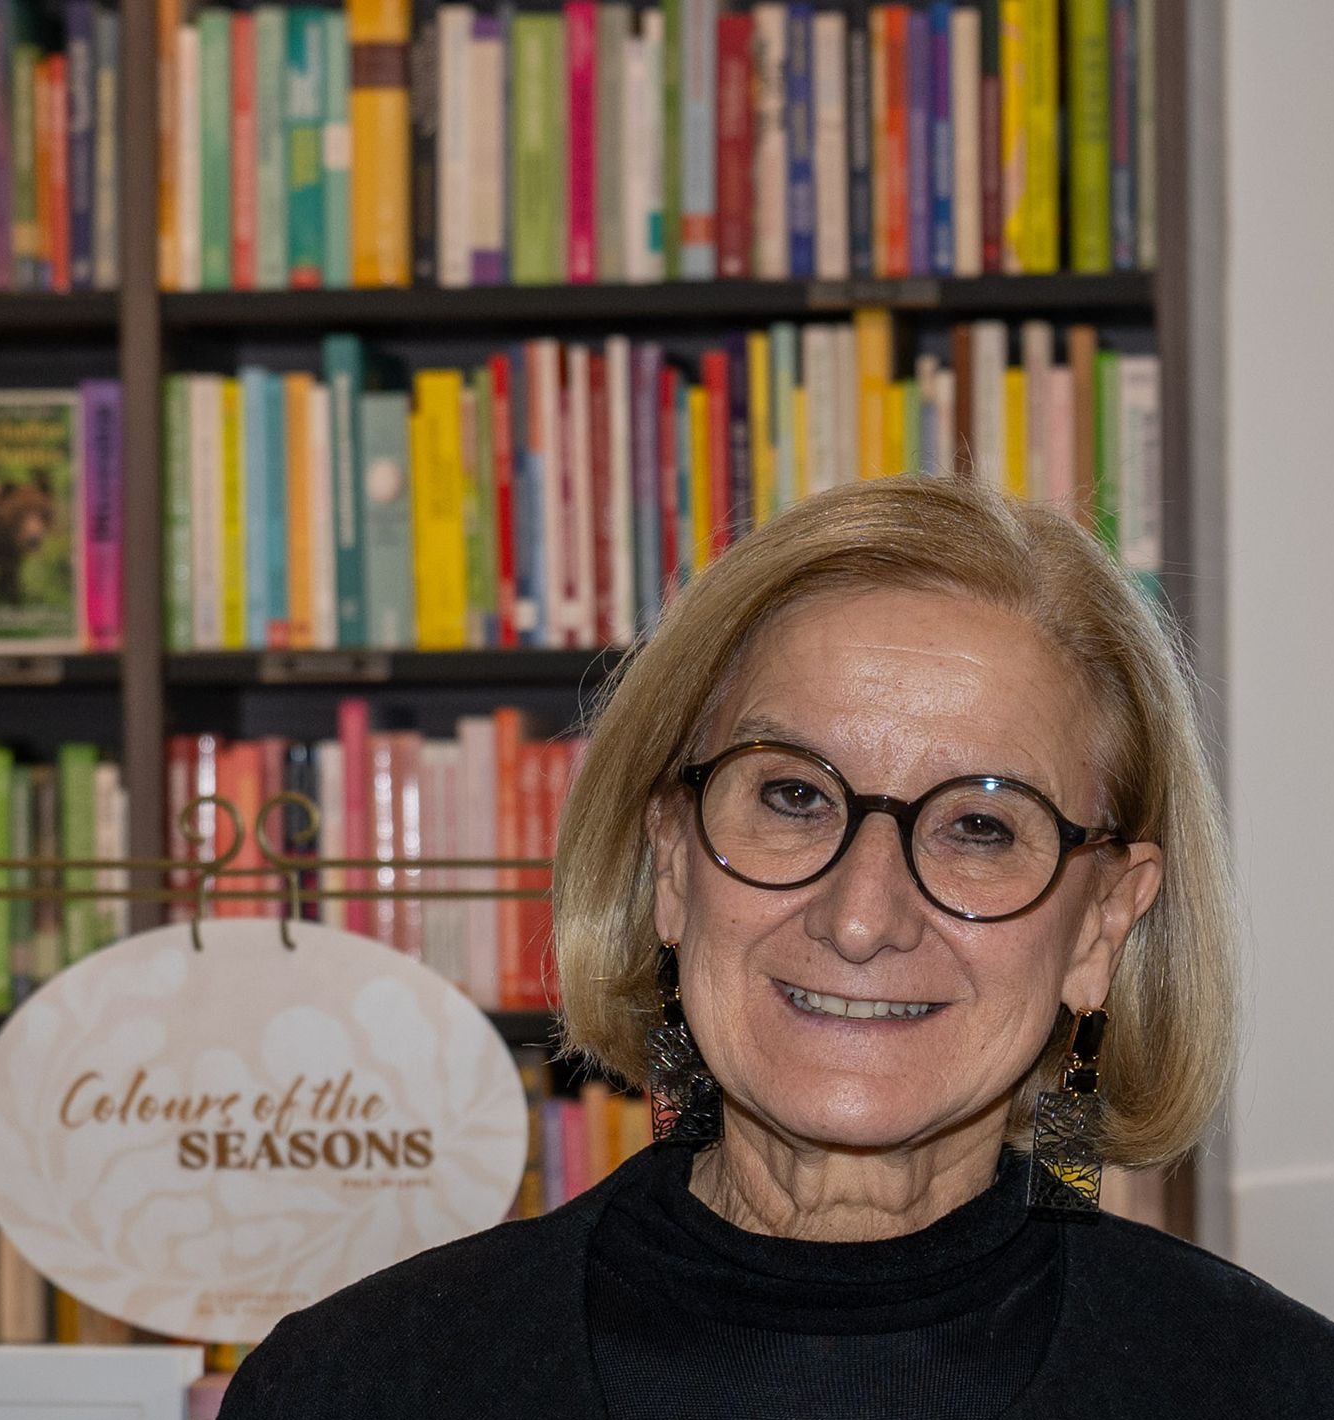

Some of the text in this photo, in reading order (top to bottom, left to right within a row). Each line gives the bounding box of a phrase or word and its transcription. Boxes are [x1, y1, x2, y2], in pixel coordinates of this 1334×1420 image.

[59, 1070, 384, 1137] Colours of the
[178, 1127, 435, 1172] SEASONS
